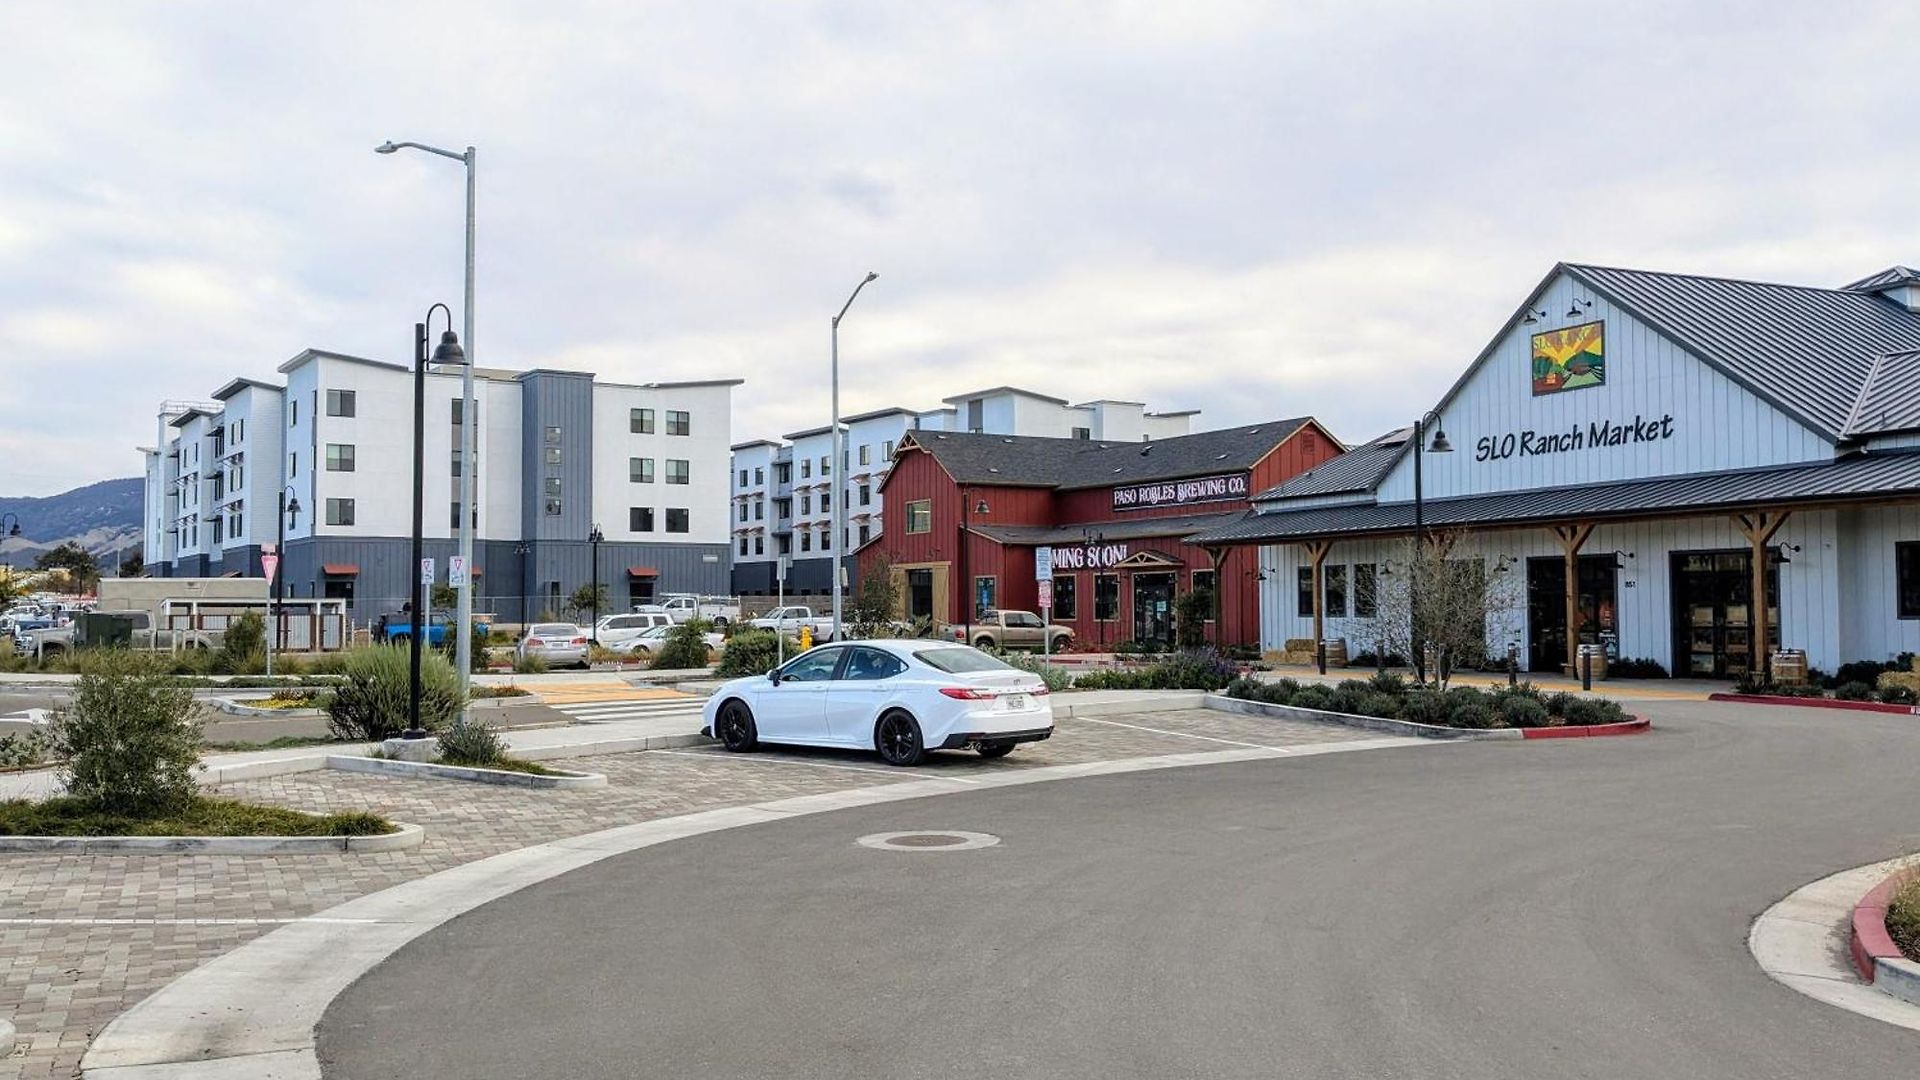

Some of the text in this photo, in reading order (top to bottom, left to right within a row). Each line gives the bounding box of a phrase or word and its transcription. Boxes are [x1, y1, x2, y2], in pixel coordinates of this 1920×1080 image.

[1476, 414, 1674, 462] SLO Ranch Market
[1114, 477, 1246, 506] PASO ROBLES BREWING CO.
[1051, 547, 1084, 569] MING
